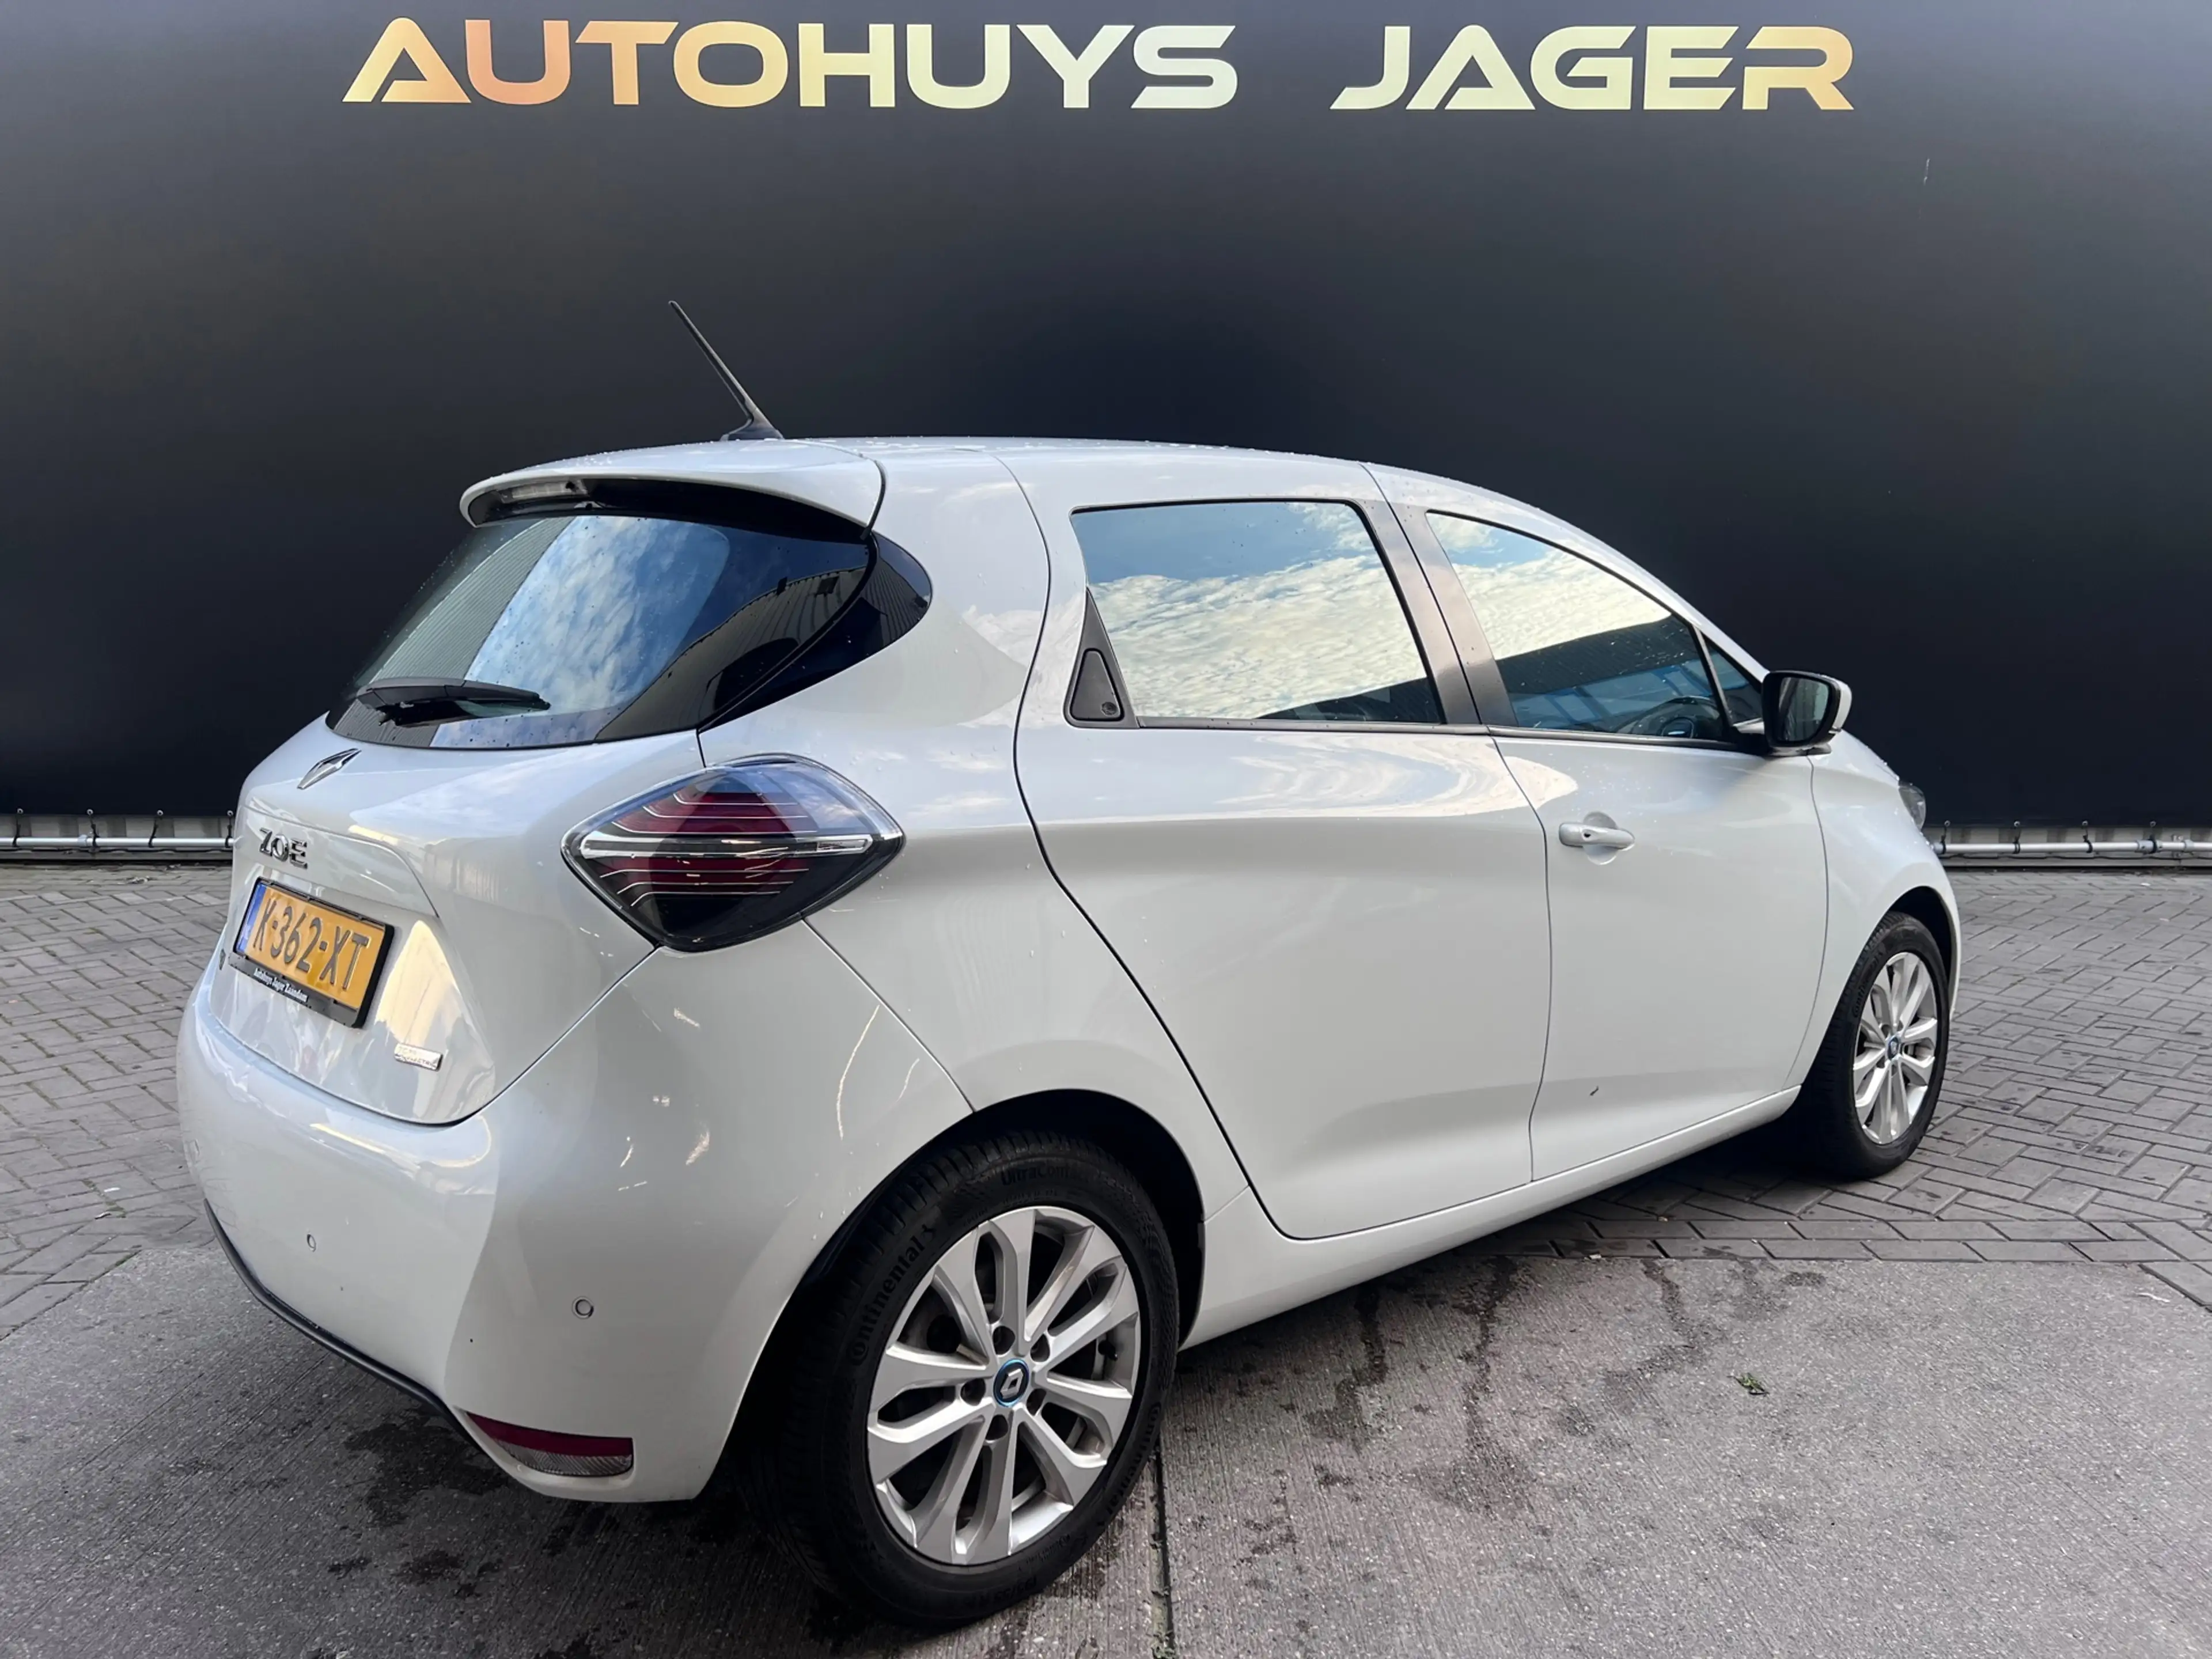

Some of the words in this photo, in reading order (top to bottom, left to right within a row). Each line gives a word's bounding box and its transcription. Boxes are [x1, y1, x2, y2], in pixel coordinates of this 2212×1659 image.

[342, 17, 1238, 109] AUTOHUYS
[1330, 24, 1854, 110] JAGER
[259, 827, 308, 870] ZOE
[252, 897, 370, 990] K-362-XT
[846, 1234, 926, 1366] Continental
